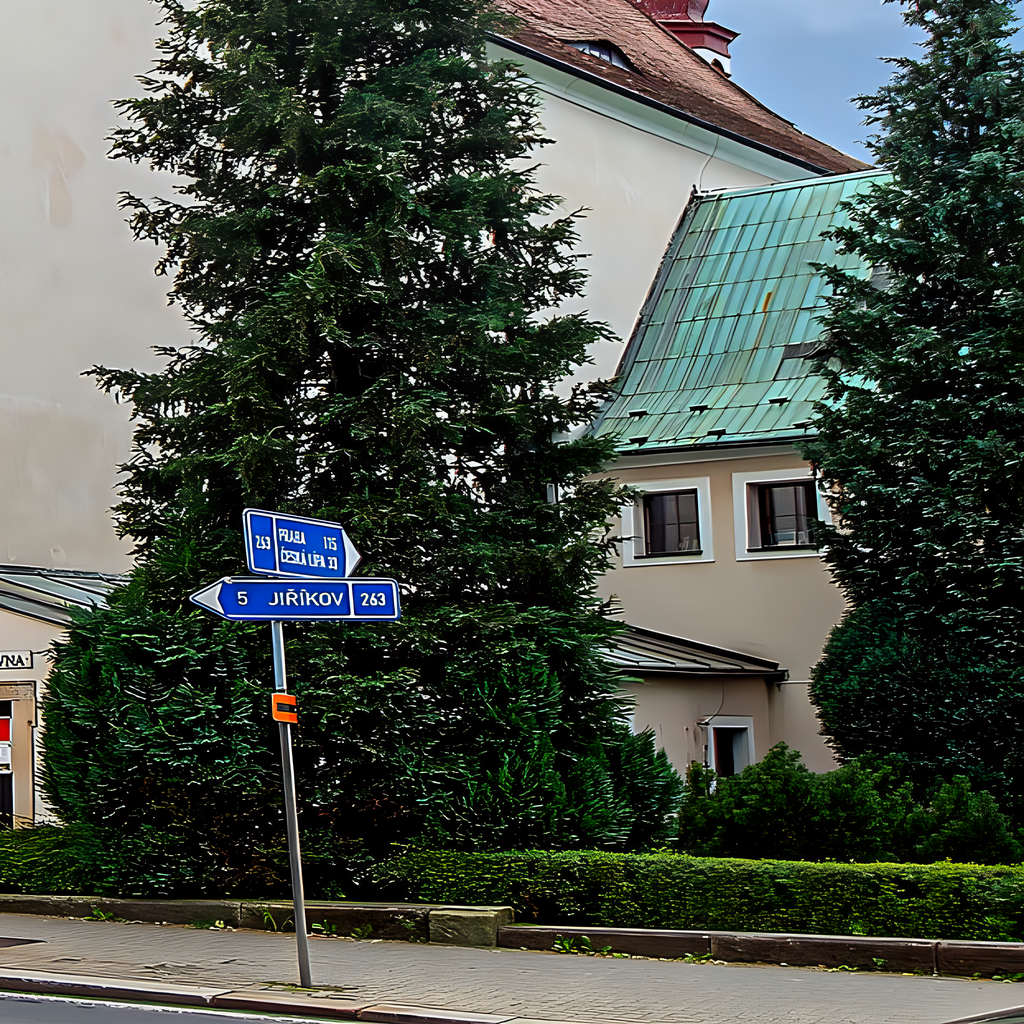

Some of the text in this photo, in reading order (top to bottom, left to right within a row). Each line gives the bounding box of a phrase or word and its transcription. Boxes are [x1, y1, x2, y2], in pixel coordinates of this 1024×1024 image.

[255, 535, 271, 550] 263
[237, 591, 248, 605] 5
[360, 592, 386, 606] 263
